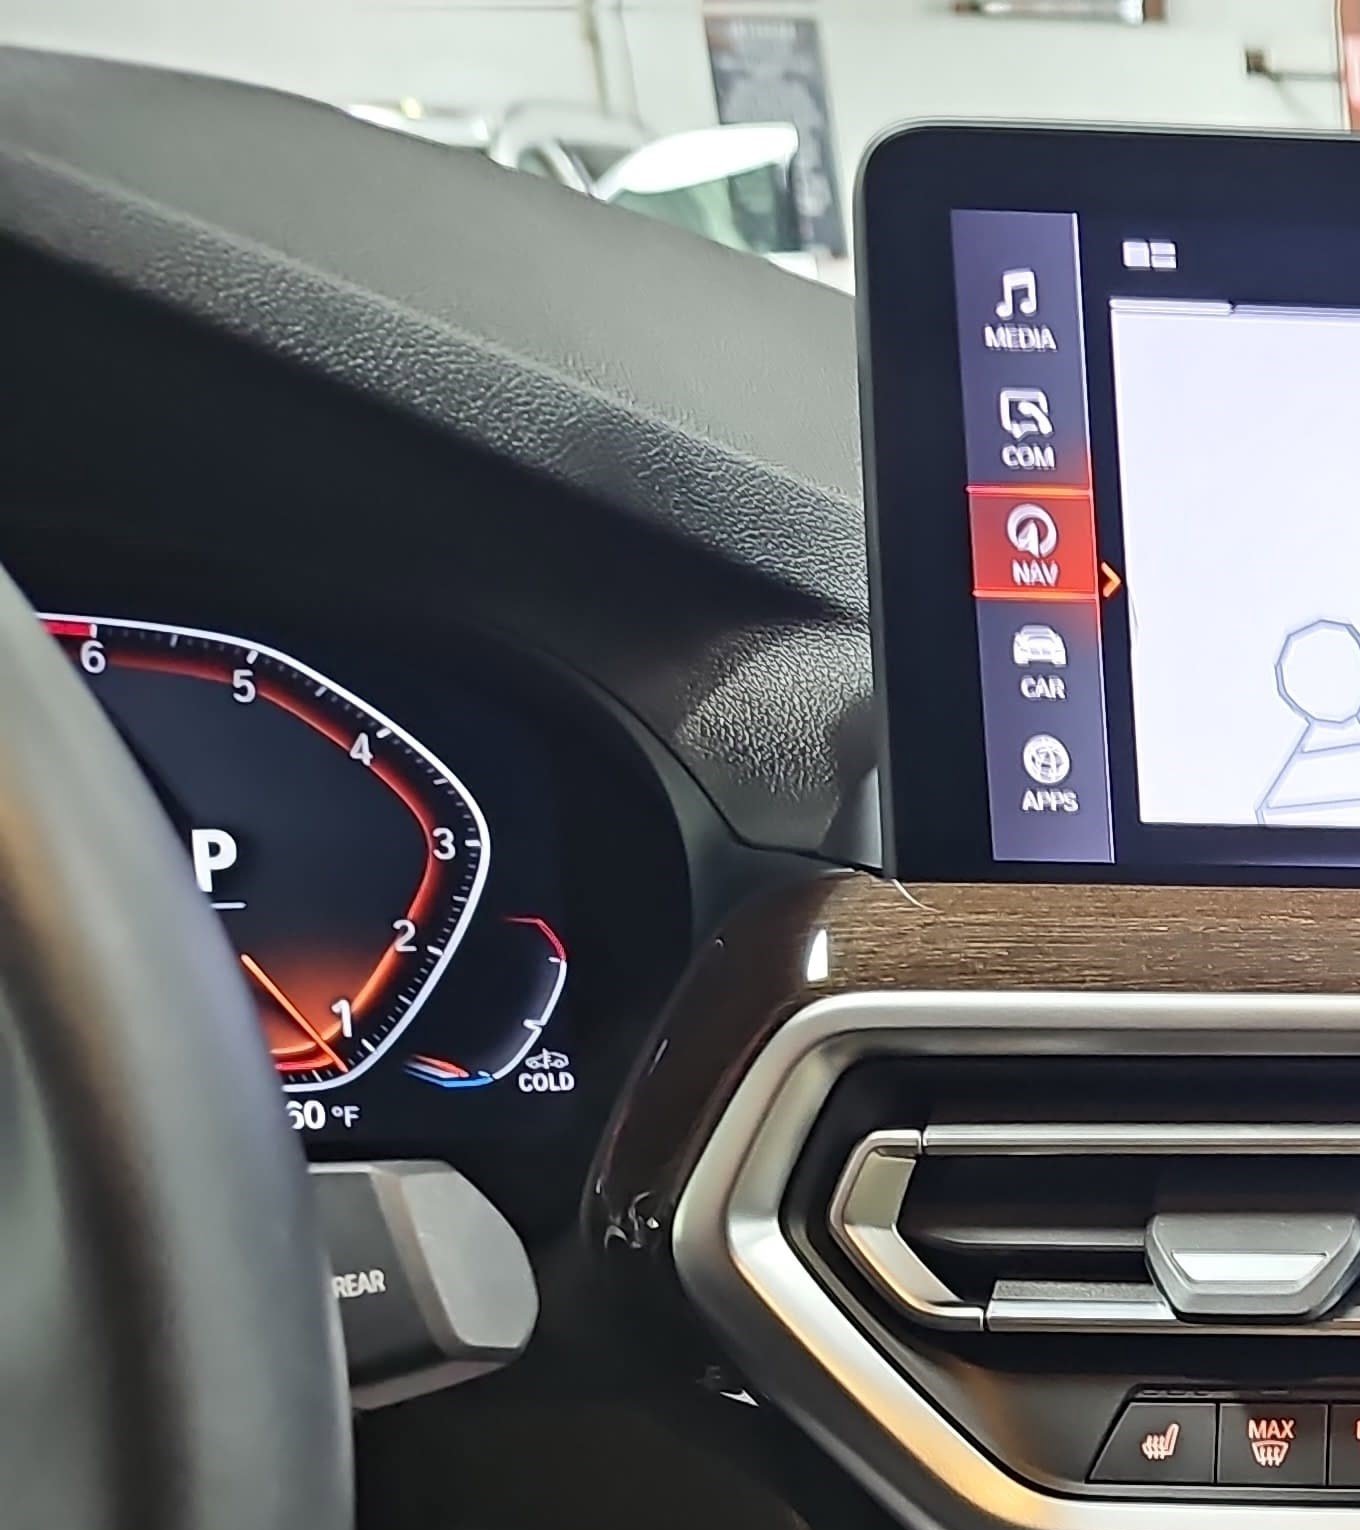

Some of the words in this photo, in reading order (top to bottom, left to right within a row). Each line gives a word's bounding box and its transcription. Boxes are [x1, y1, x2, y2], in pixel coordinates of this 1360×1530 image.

[984, 323, 1058, 353] MEDIA
[1001, 443, 1056, 471] COM
[1011, 559, 1059, 588] NAV
[79, 644, 107, 675] 6
[232, 672, 257, 705] 5
[1019, 674, 1066, 702] CAR
[349, 733, 373, 766] 4
[1021, 788, 1079, 815] APPS
[432, 828, 457, 860] 3
[191, 828, 238, 893] P
[393, 920, 418, 953] 2
[332, 999, 353, 1038] 1
[518, 1073, 575, 1093] COLD
[331, 1269, 387, 1299] REAR
[1248, 1420, 1294, 1440] MAX
